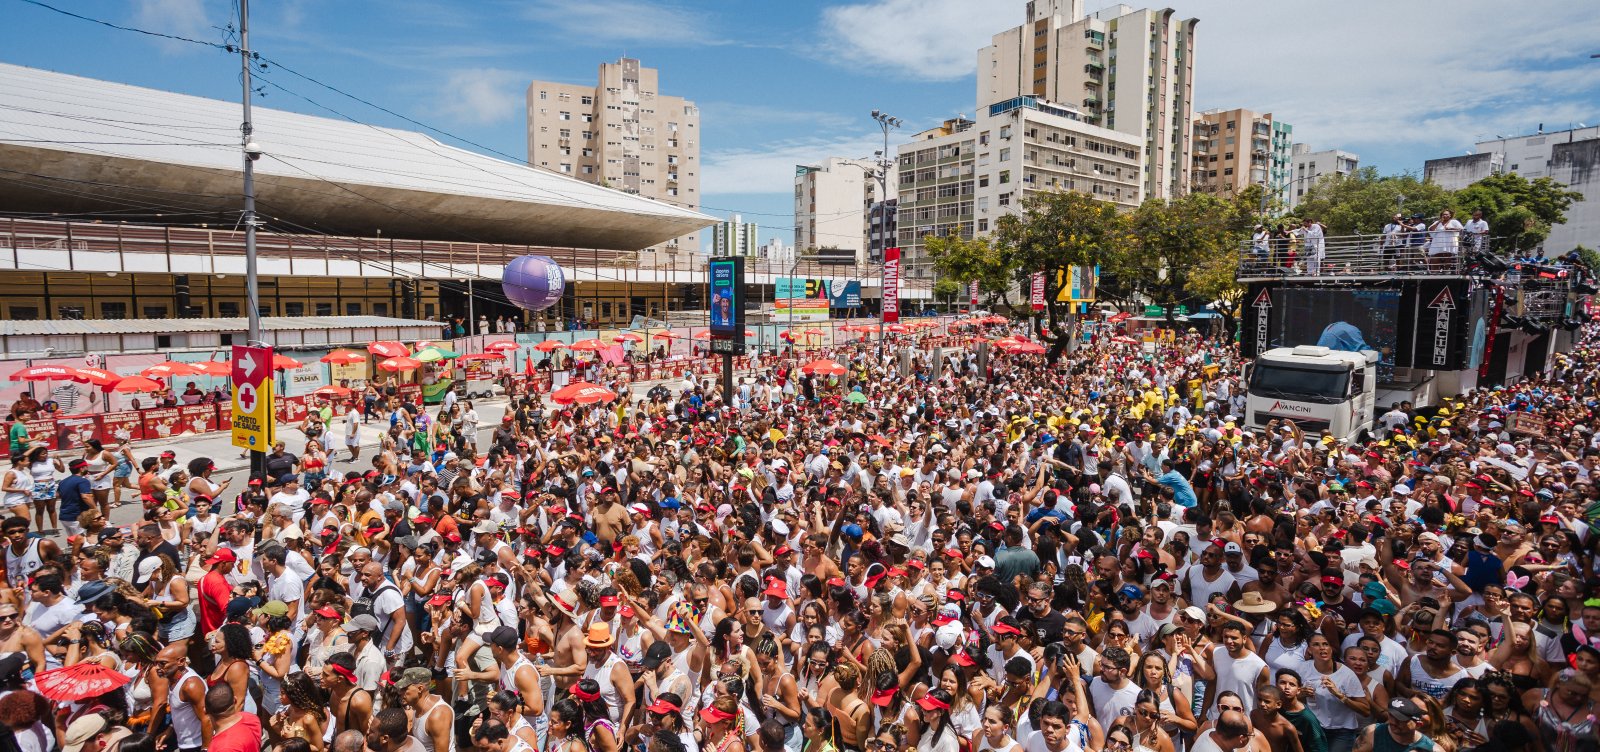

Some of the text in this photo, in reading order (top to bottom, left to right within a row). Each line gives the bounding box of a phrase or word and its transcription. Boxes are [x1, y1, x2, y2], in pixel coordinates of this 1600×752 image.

[884, 259, 898, 313] BRAHMA
[1269, 400, 1312, 413] AVANCINI
[233, 421, 241, 429] DE
[238, 415, 257, 425] POSTO
